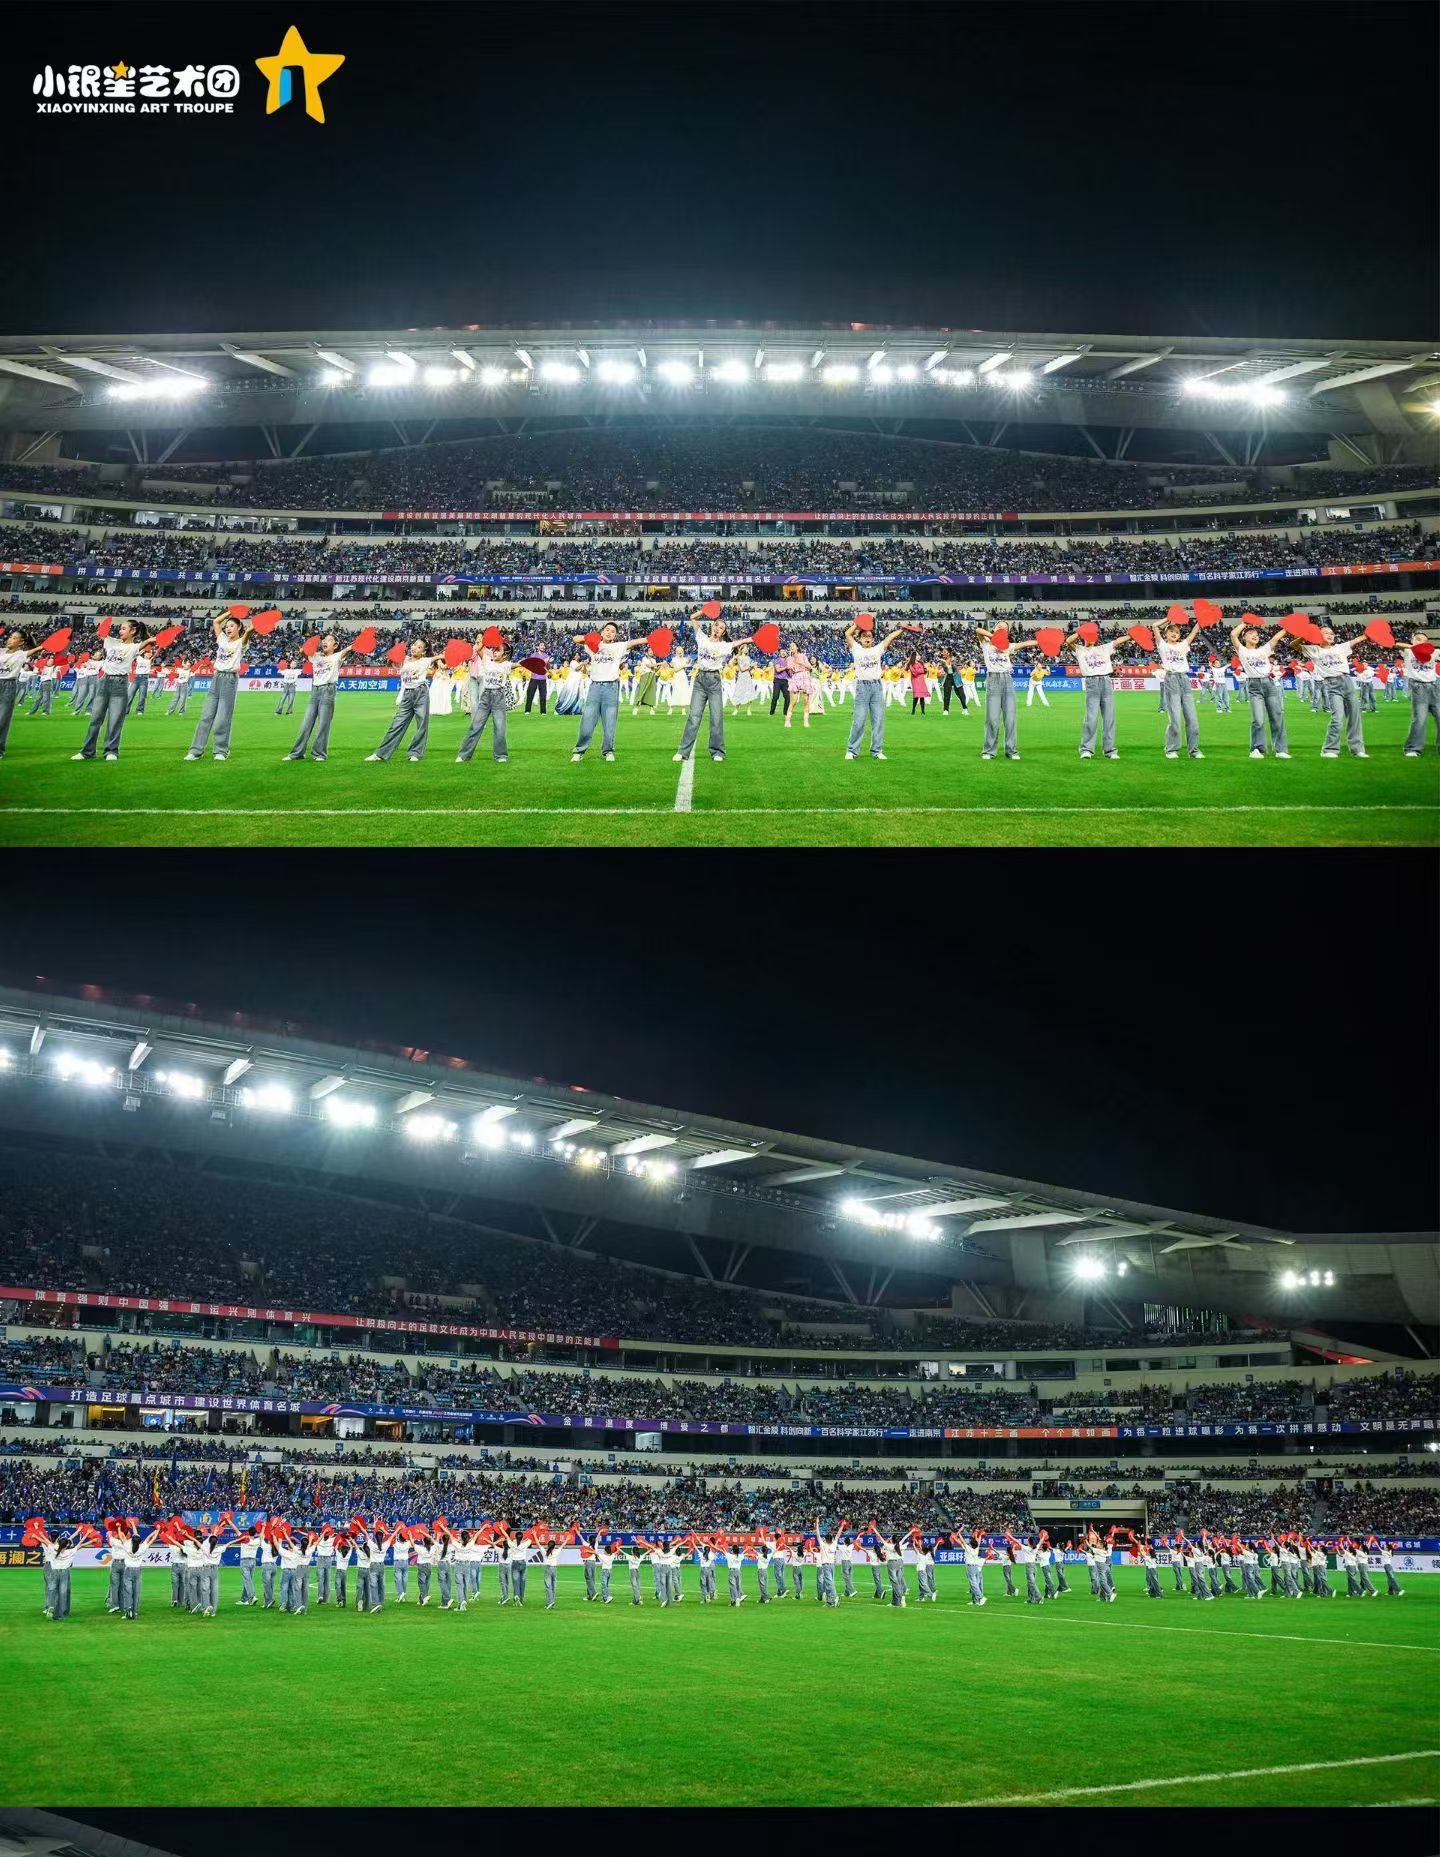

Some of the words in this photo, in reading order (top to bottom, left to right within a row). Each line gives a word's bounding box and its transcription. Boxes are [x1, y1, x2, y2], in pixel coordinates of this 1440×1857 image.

[348, 678, 388, 690] 天加空调
[34, 1289, 169, 1311] 体育强则中国强
[190, 1302, 312, 1323] 国运兴则体育兴
[355, 1317, 601, 1347] 让积极向上的足球文化成为中国人民实现中国梦的正能量
[70, 1389, 185, 1407] 打造足球重点城市
[194, 1396, 300, 1412] 建设世界体育名城
[563, 1416, 634, 1429] 金陵温度
[0, 1551, 45, 1565] 海澜之
